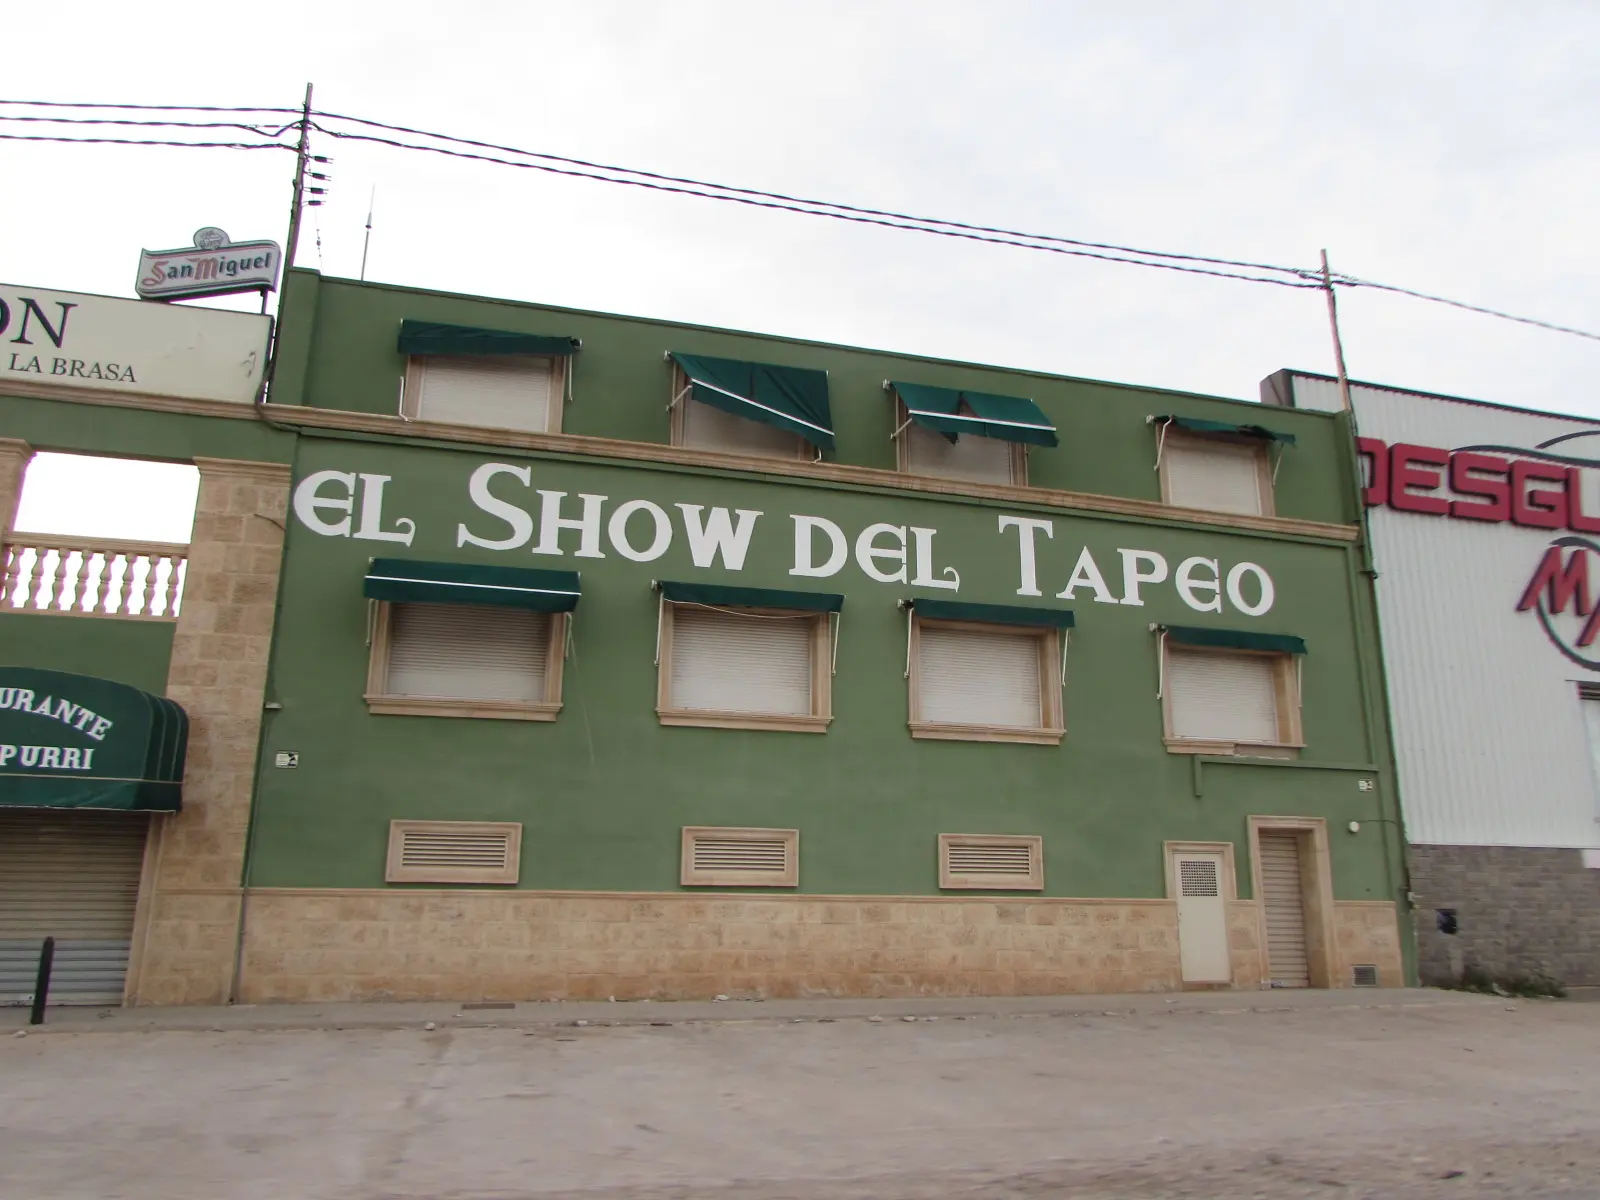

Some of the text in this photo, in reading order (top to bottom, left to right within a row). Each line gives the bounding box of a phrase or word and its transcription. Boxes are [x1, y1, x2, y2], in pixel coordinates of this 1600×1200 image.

[187, 252, 272, 280] Miguel
[0, 297, 79, 349] N
[8, 353, 137, 383] LA BRASA
[293, 462, 1275, 617] EL SHOW DEL TAPEO
[0, 687, 114, 741] URANTE
[0, 744, 96, 770] PURRI
